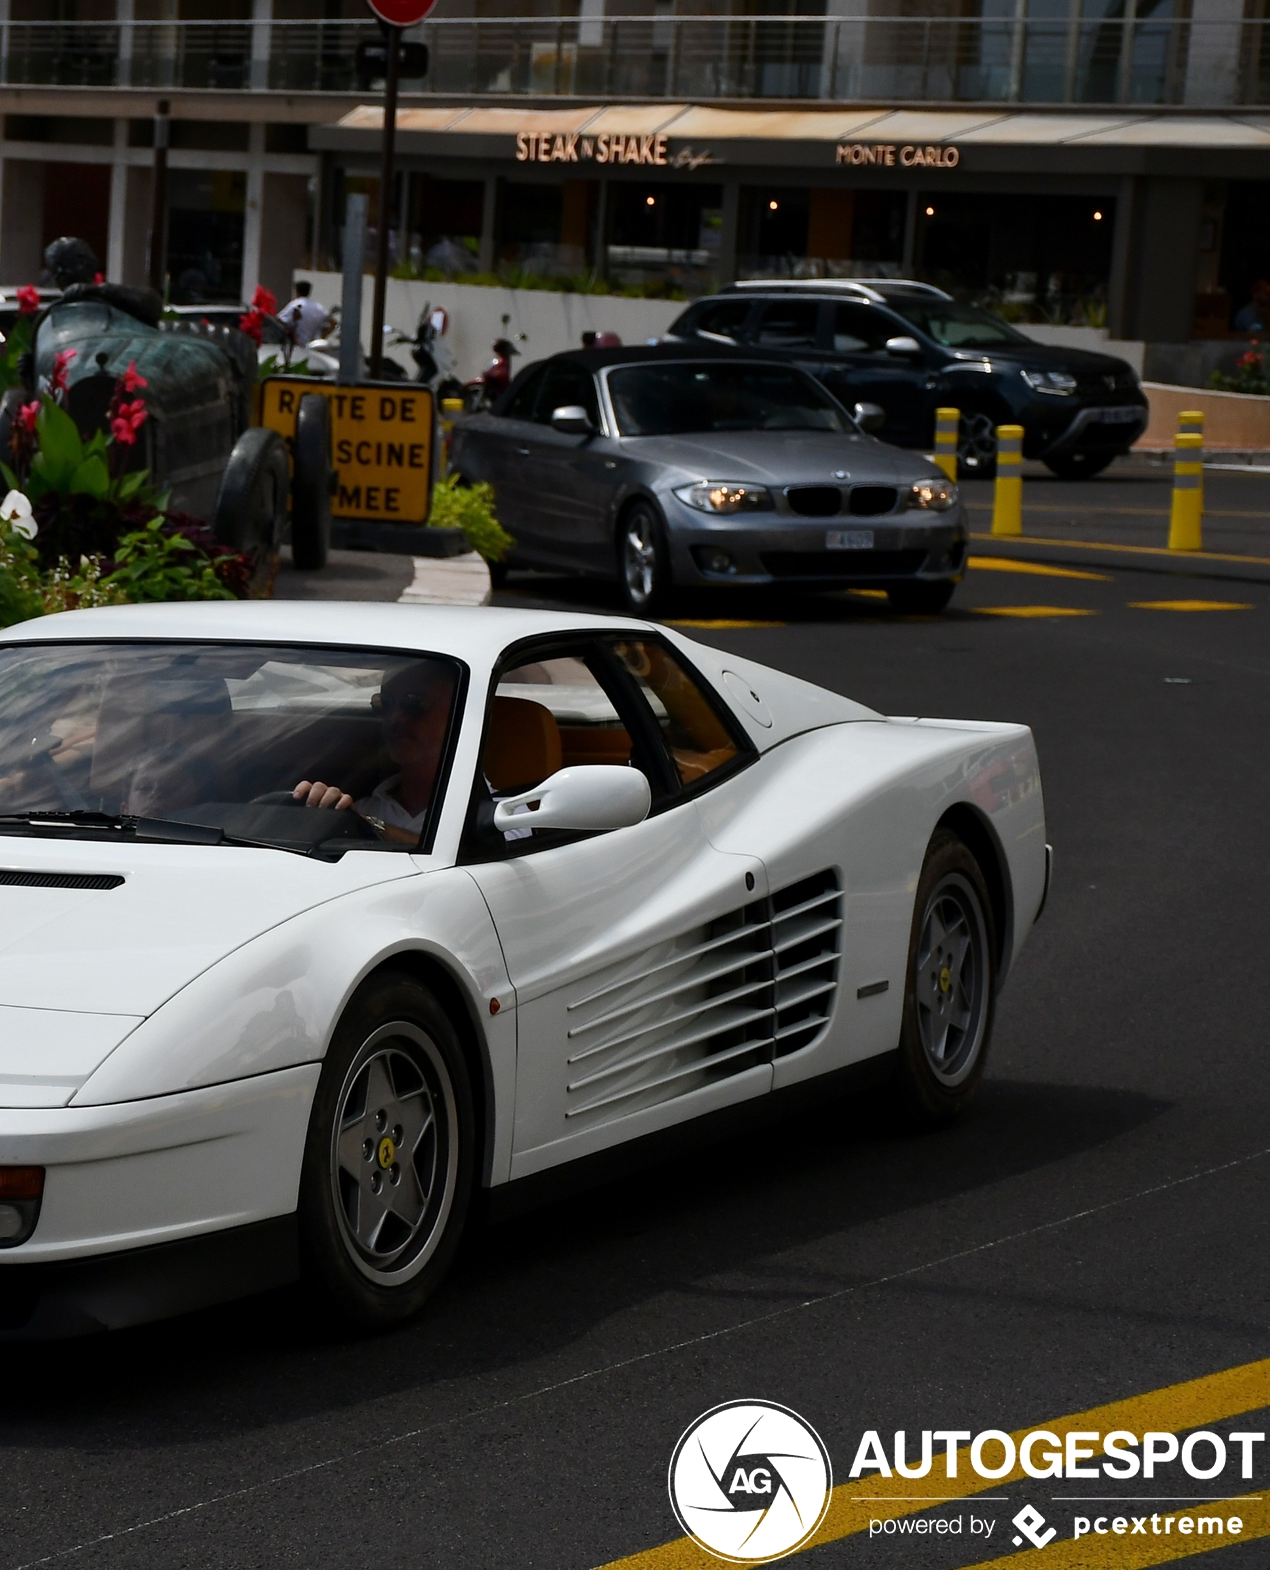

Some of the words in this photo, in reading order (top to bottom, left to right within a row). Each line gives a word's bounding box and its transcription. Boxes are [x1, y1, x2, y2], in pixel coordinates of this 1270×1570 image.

[516, 131, 580, 162] STEAK
[596, 132, 668, 165] SHAKE
[836, 144, 896, 166] MONTE
[900, 145, 960, 168] CARLO
[279, 390, 366, 420] RTE
[380, 397, 415, 422] DE
[337, 440, 424, 468] SCINE
